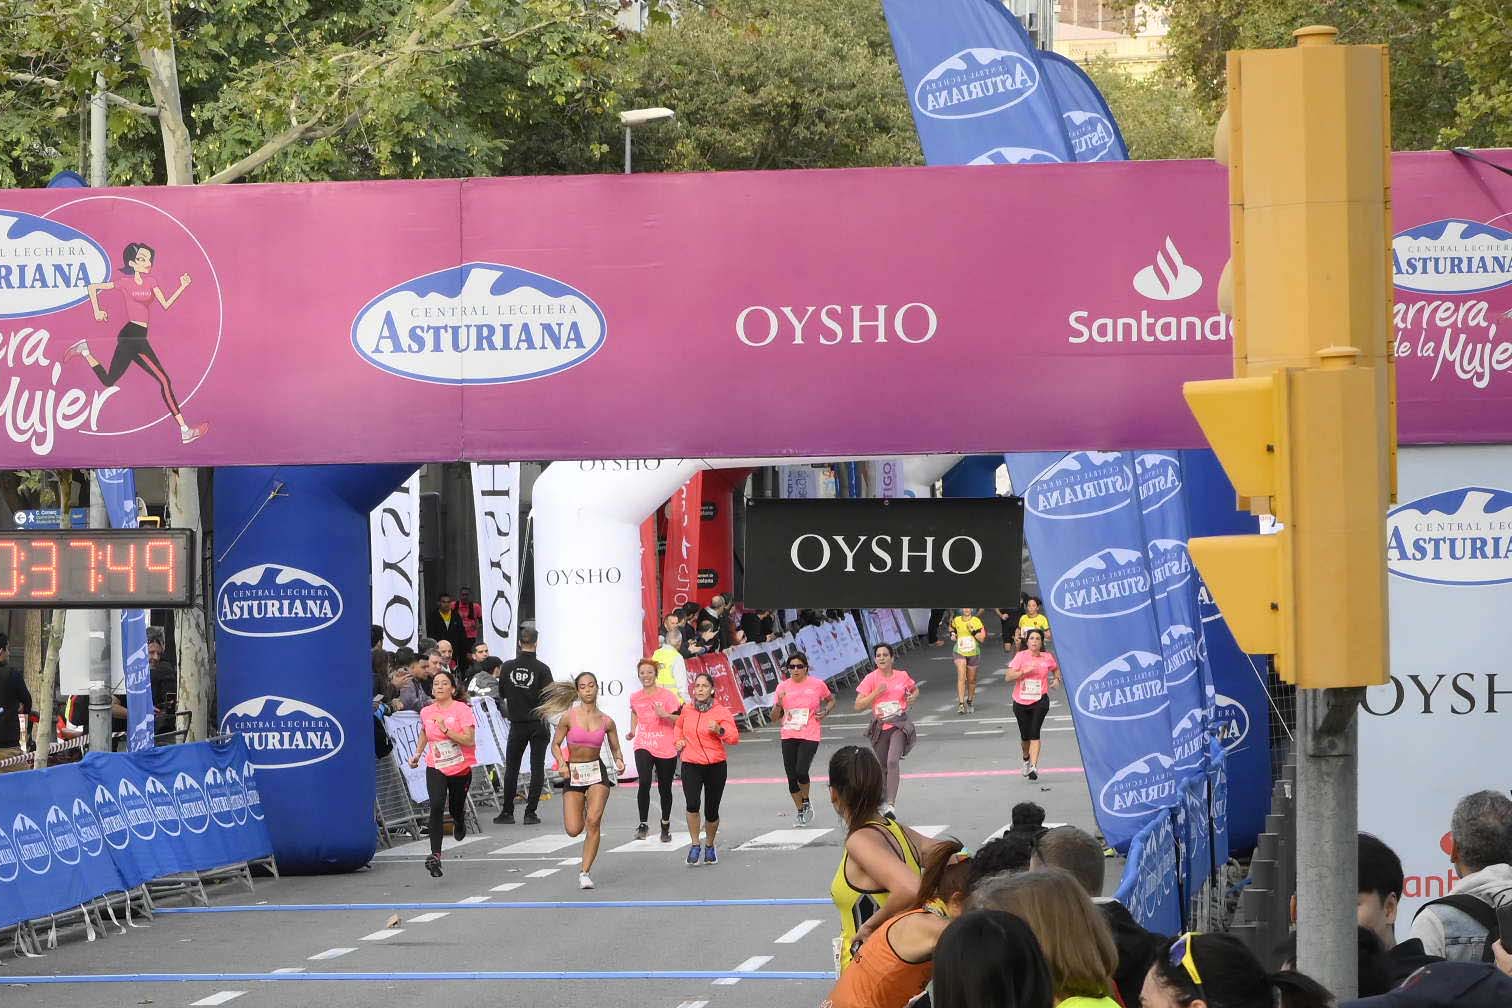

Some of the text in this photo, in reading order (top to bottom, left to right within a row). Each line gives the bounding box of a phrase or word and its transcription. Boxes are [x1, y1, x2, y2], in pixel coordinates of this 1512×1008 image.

[14, 246, 86, 257] LECHERA
[410, 303, 578, 318] CENTRAL LECHERA
[735, 301, 938, 347] OYSHO
[1393, 299, 1489, 329] arrera
[371, 310, 586, 354] ASTURIANA
[1068, 309, 1233, 344] Santand
[1417, 330, 1435, 357] la
[1430, 323, 1512, 389] Muje
[1414, 521, 1482, 531] CENTRAL
[790, 533, 983, 575] OYSHO
[545, 566, 622, 587] OYSHO
[233, 588, 329, 598] CENTRAL LECHERA
[220, 594, 334, 621] ASTURIANA
[235, 720, 330, 729] CENTRAL LECHERA
